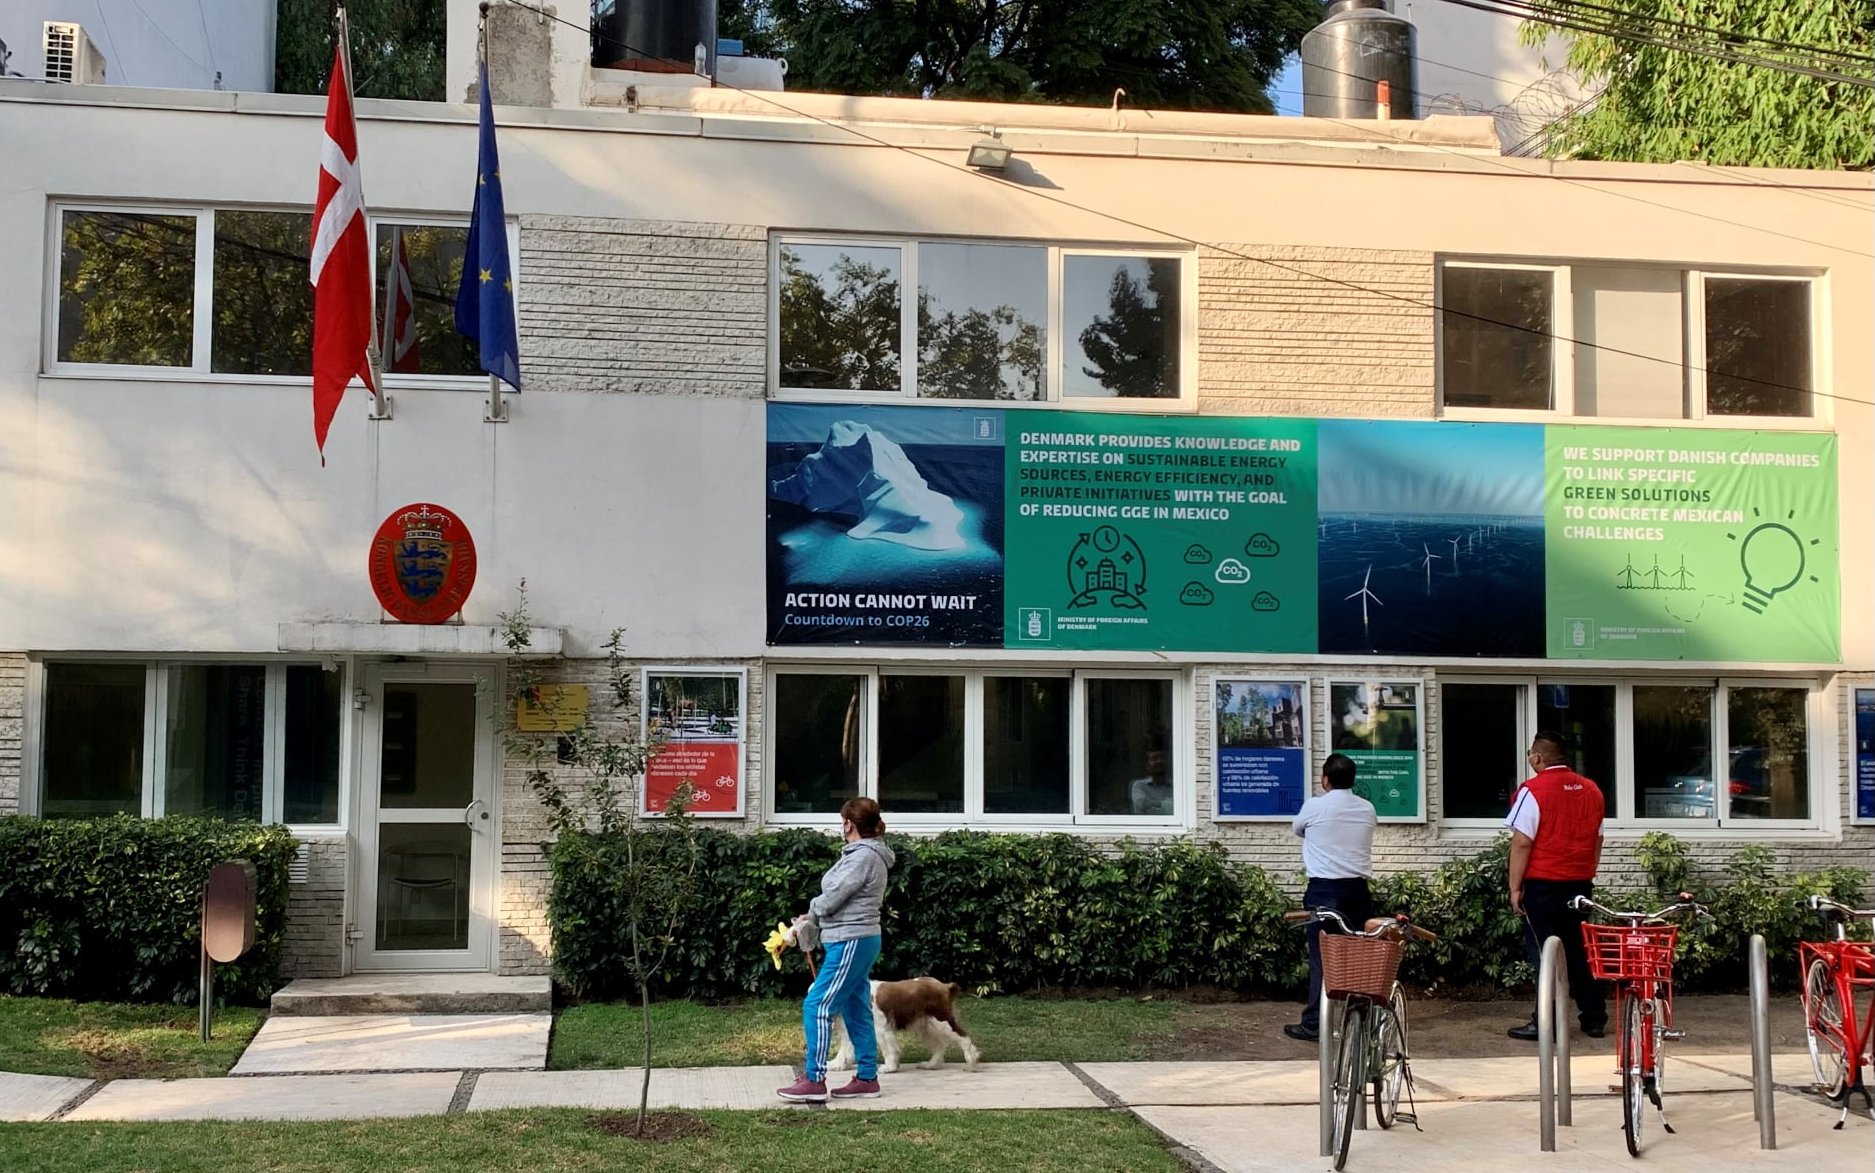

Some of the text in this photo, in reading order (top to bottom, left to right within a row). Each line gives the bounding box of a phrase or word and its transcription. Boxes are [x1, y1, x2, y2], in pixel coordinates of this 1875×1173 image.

[1020, 432, 1301, 452] DENMARK PROVIDES KNOWLEDGE AND
[1020, 450, 1287, 468] EXPERTISE ON SUSTAINABLE ENERGY
[1563, 447, 1820, 467] WE SUPPORT DANISH COMPANIES
[1020, 468, 1274, 487] SOURCES, ENERGY EFFICIENCY, AND
[1563, 466, 1696, 483] TO LINK SPECIFIC
[1020, 486, 1287, 504] PRIVATE INITIATIVES WITH THE GOAL
[1563, 486, 1711, 502] GREEN SOLUTIONS
[1020, 504, 1230, 520] OF REDUCING GGE IN MEXICO
[1563, 506, 1744, 523] TO CONCRETE MEXICAN
[1563, 525, 1664, 541] CHALLENGES
[784, 593, 977, 610] ACTION CANNOT WAIT
[784, 613, 930, 627] Countdown to COP26
[1057, 616, 1087, 624] MINISTRY
